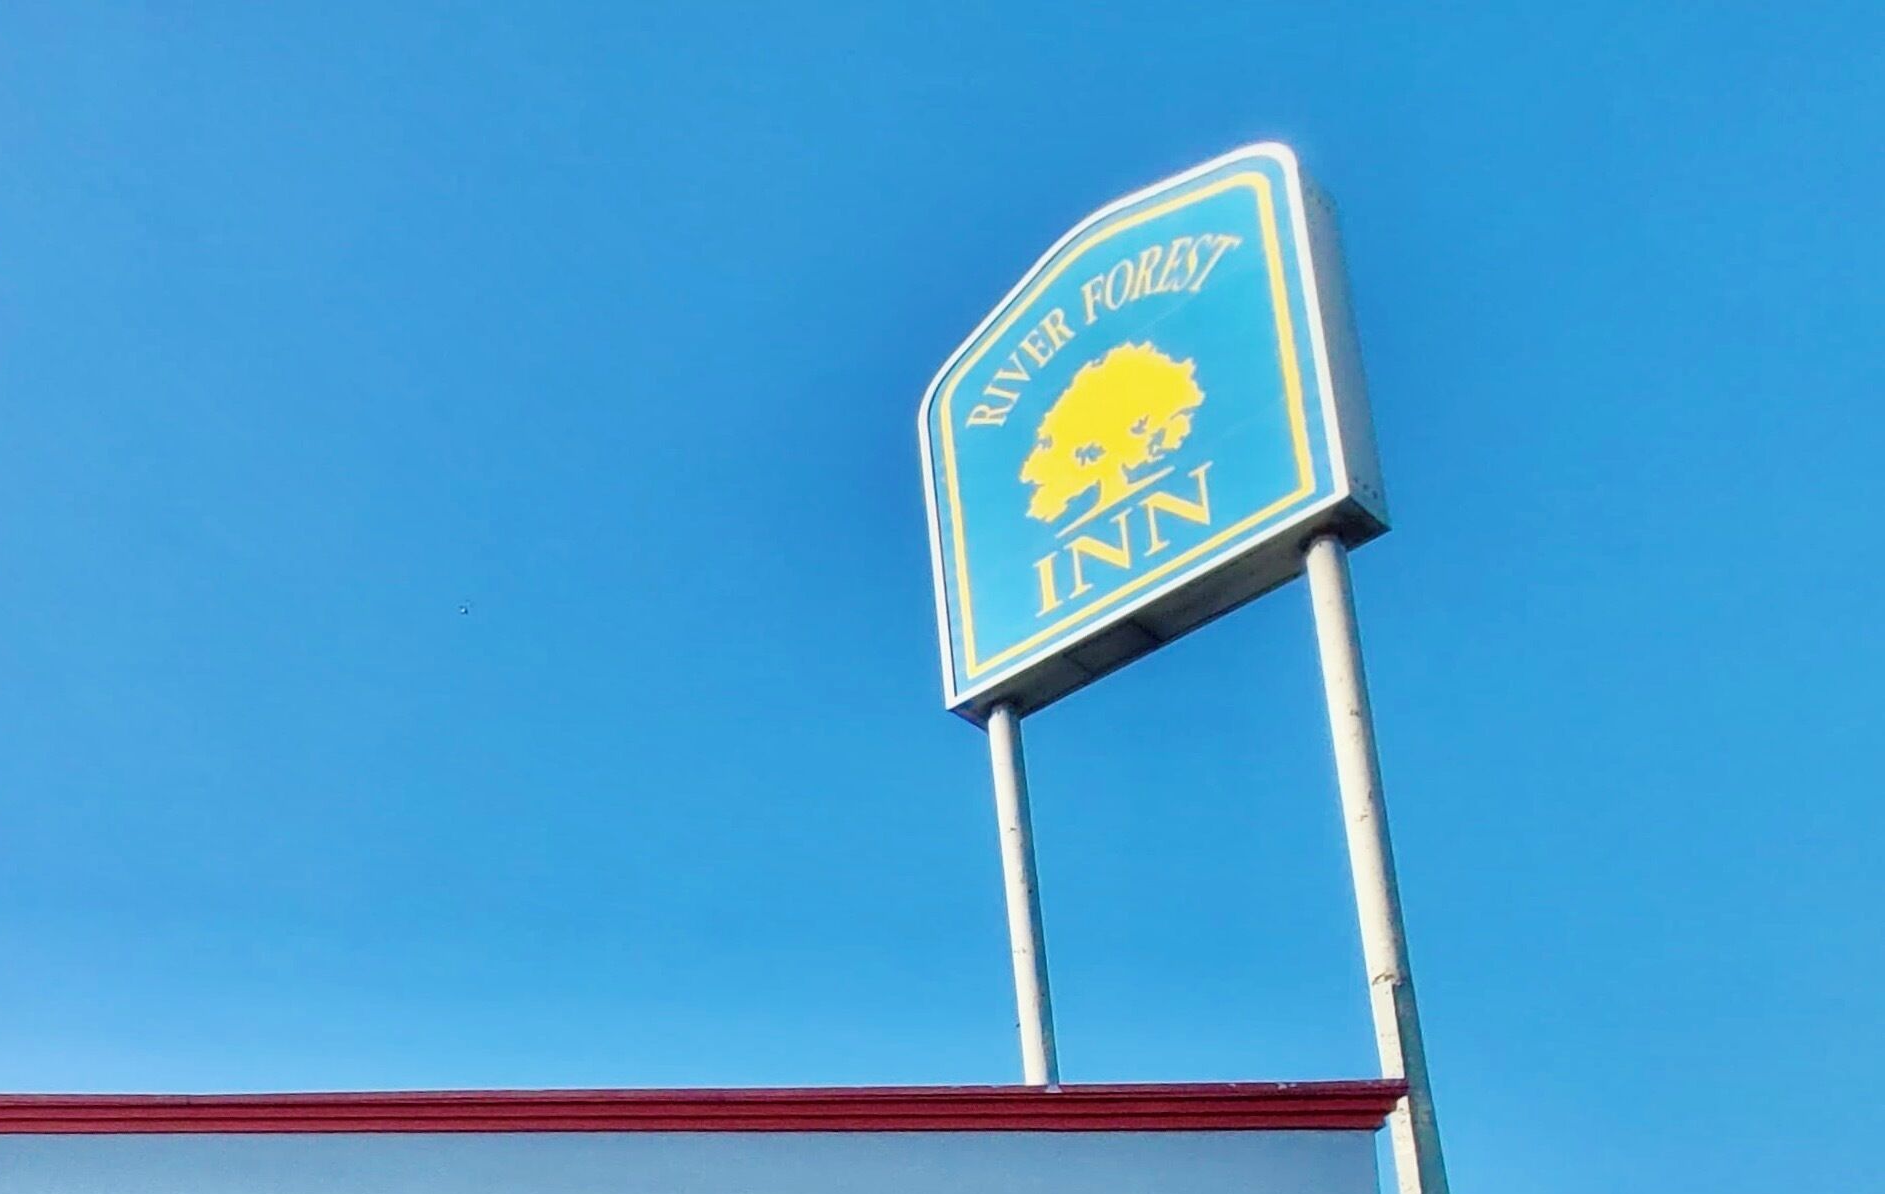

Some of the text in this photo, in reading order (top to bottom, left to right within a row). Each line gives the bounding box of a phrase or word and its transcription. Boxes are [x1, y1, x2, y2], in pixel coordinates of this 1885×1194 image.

[965, 233, 1242, 428] RIVER FOREST
[1032, 461, 1213, 618] INN
